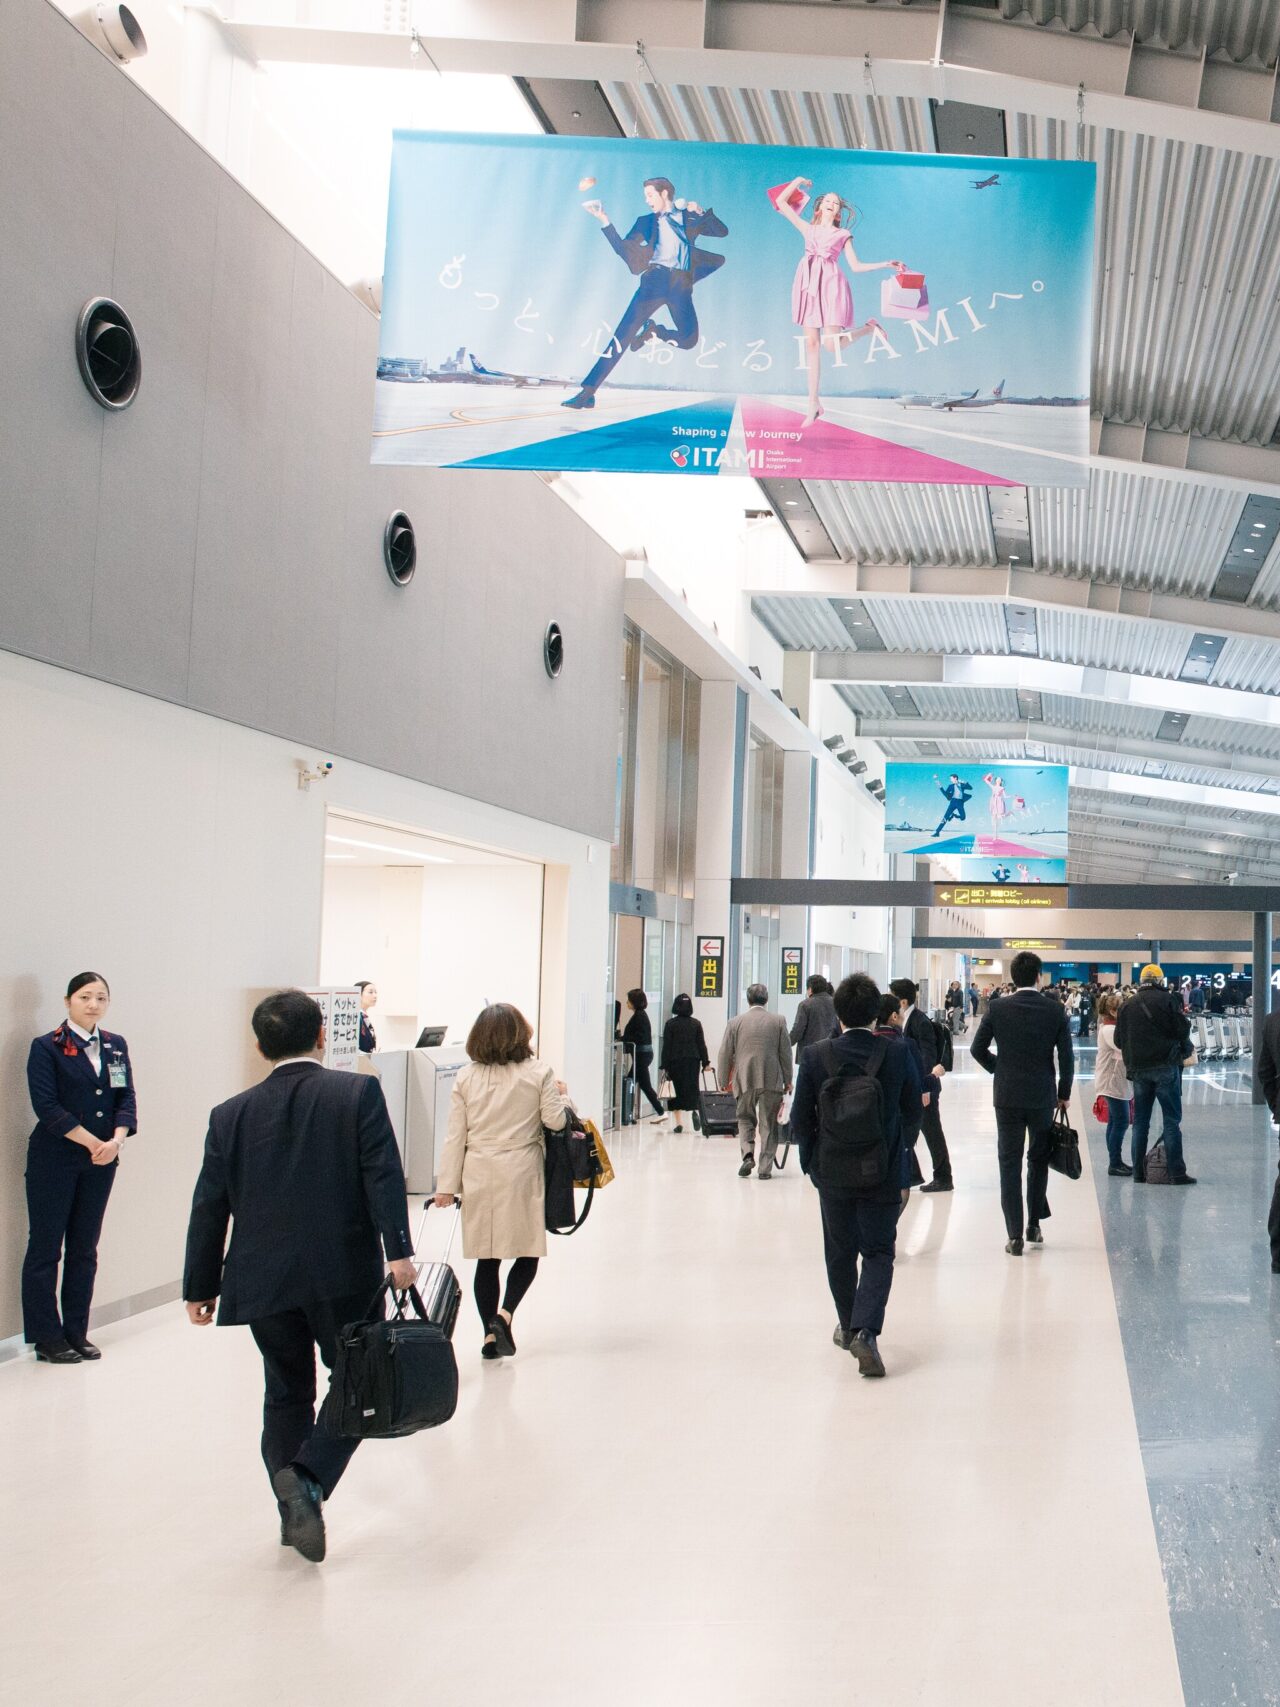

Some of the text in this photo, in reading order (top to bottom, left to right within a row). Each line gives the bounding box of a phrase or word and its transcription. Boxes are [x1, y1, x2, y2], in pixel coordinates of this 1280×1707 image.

[671, 426, 716, 439] Shaping
[720, 428, 727, 437] a
[759, 429, 803, 441] Journey
[693, 446, 764, 469] ITAMI
[703, 958, 717, 990] 出口
[786, 964, 798, 989] 出口
[1181, 975, 1192, 988] 2
[1213, 972, 1226, 989] 3
[333, 1013, 358, 1026] おでかけ
[333, 1029, 358, 1042] サービス
